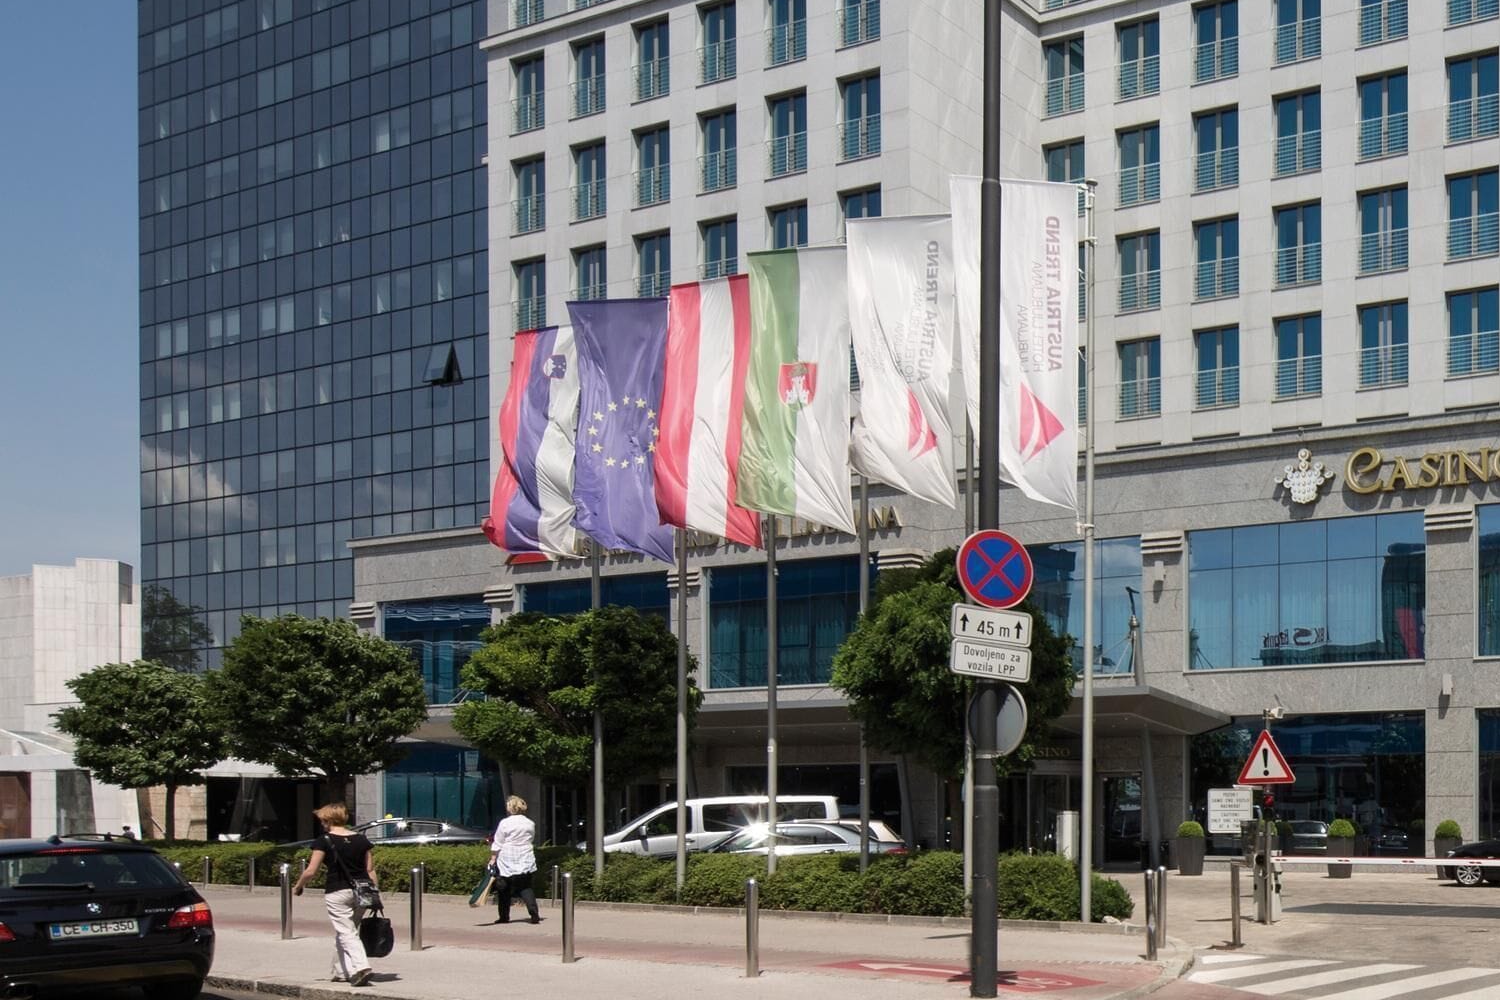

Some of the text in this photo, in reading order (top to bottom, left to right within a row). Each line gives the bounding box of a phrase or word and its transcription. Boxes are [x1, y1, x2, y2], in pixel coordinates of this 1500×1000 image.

[977, 620, 1010, 638] 45 m
[963, 645, 1021, 663] Dovoljeno za
[967, 662, 1015, 675] vozila LPP
[63, 924, 81, 935] CE
